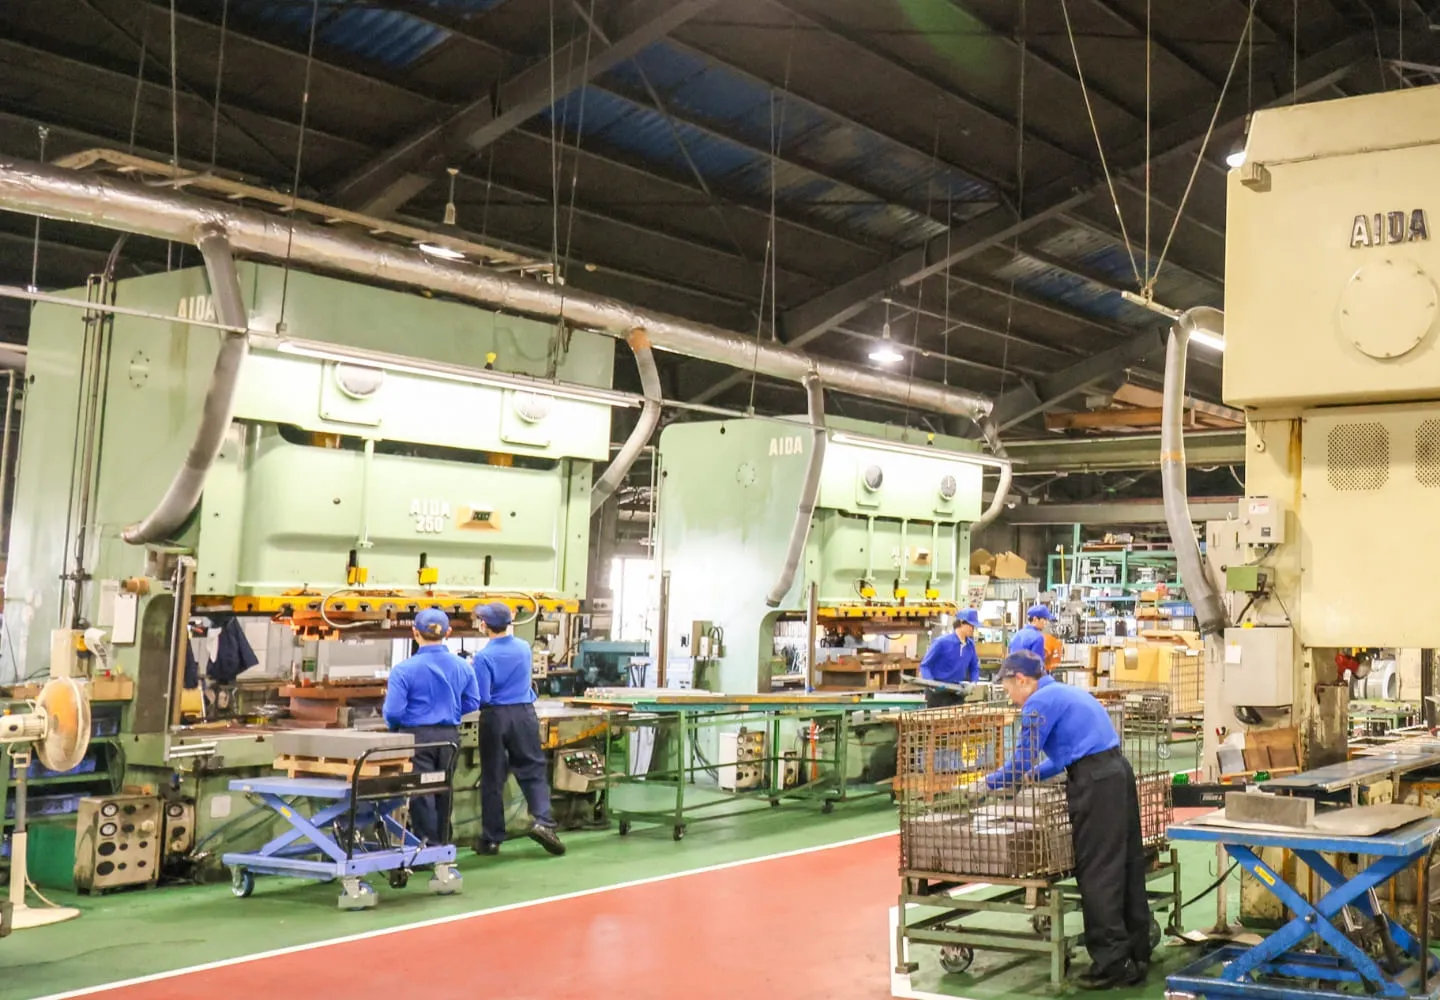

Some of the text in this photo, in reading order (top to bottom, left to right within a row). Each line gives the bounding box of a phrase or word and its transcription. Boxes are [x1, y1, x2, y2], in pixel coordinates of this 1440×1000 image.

[1350, 209, 1427, 248] AIDA
[178, 295, 216, 321] AIDA
[769, 436, 803, 456] AIDA
[409, 499, 449, 518] AIDA
